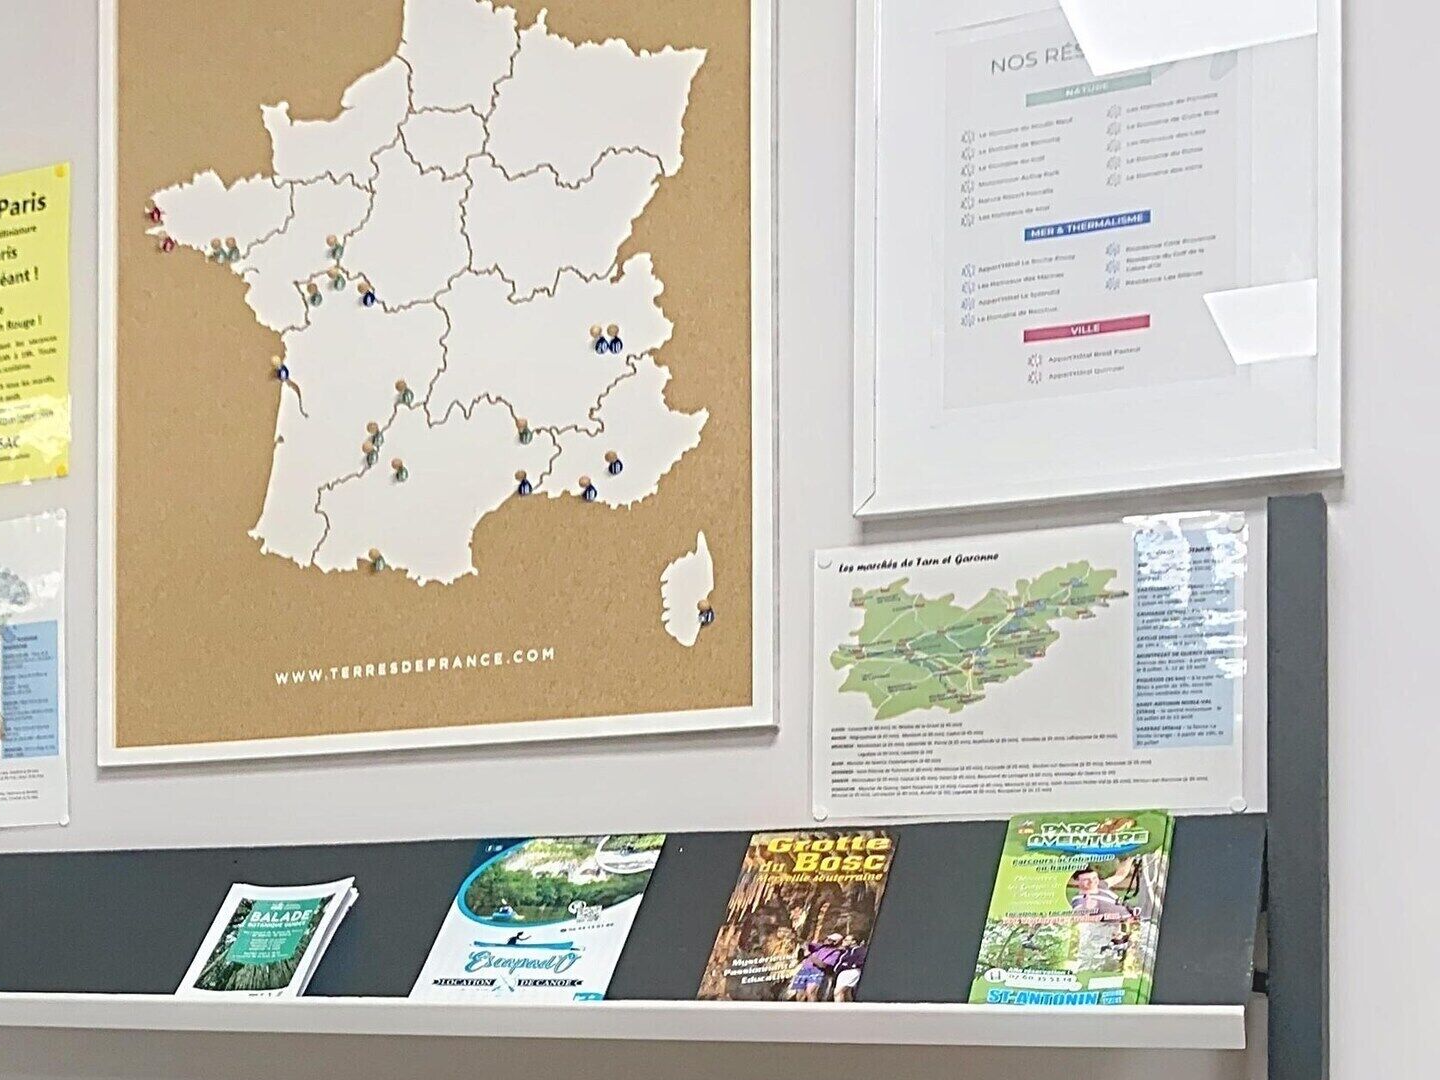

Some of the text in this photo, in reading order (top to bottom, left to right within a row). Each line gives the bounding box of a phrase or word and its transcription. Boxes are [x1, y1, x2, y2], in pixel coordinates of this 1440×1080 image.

[991, 52, 1038, 74] NOS
[1031, 213, 1144, 238] MER THERMALISME
[1071, 323, 1100, 336] VILLE
[857, 551, 999, 573] marchés Garonne
[275, 647, 554, 685] WWW.TERRESDEFRANCE.COM
[1040, 822, 1099, 834] PARC
[767, 835, 892, 853] Grotte
[759, 852, 886, 872] du Bosc
[250, 910, 312, 922] BALADE
[986, 988, 1099, 1006] ST-ANTONIN
